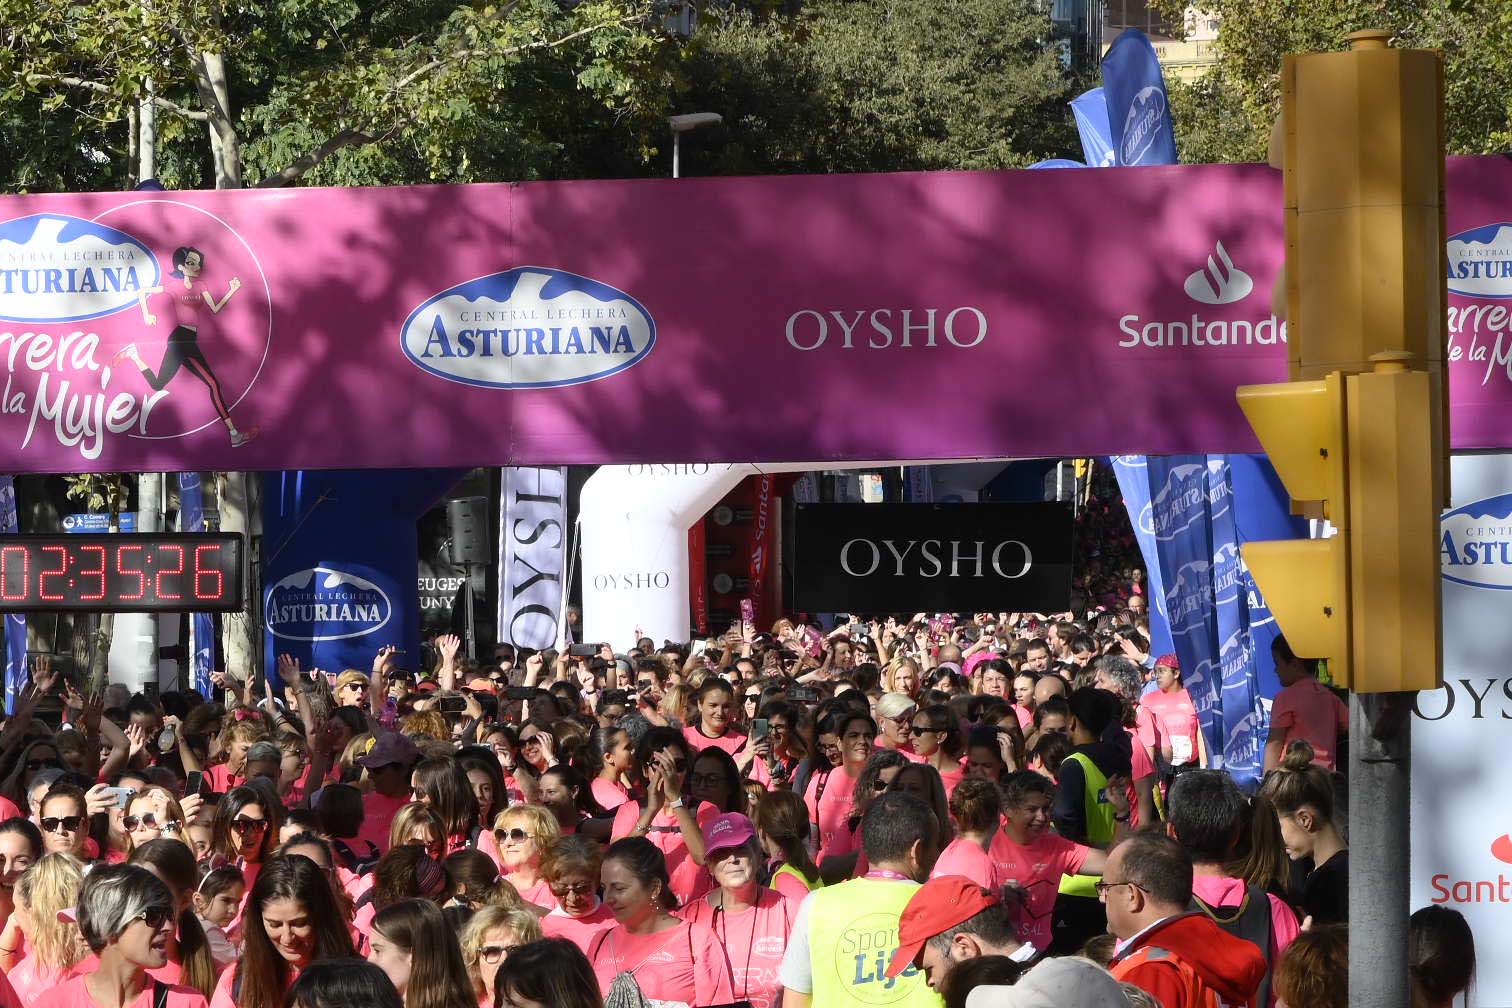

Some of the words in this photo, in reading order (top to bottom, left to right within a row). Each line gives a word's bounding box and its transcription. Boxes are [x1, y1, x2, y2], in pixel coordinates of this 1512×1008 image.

[63, 249, 136, 262] LECHERA
[460, 310, 538, 322] CENTRAL
[547, 308, 627, 320] LECHERA
[785, 306, 988, 351] OYSHO
[1118, 314, 1287, 348] Santand
[420, 314, 638, 359] ASTURIANA
[1, 374, 26, 415] la
[21, 365, 170, 461] Mujer
[1, 545, 223, 600] 02:35:26
[510, 466, 563, 650] OYSH
[839, 537, 1034, 579] OYSHO
[593, 571, 671, 592] OYSHO
[269, 598, 381, 625] ASTURIANA
[843, 927, 898, 955] Spor
